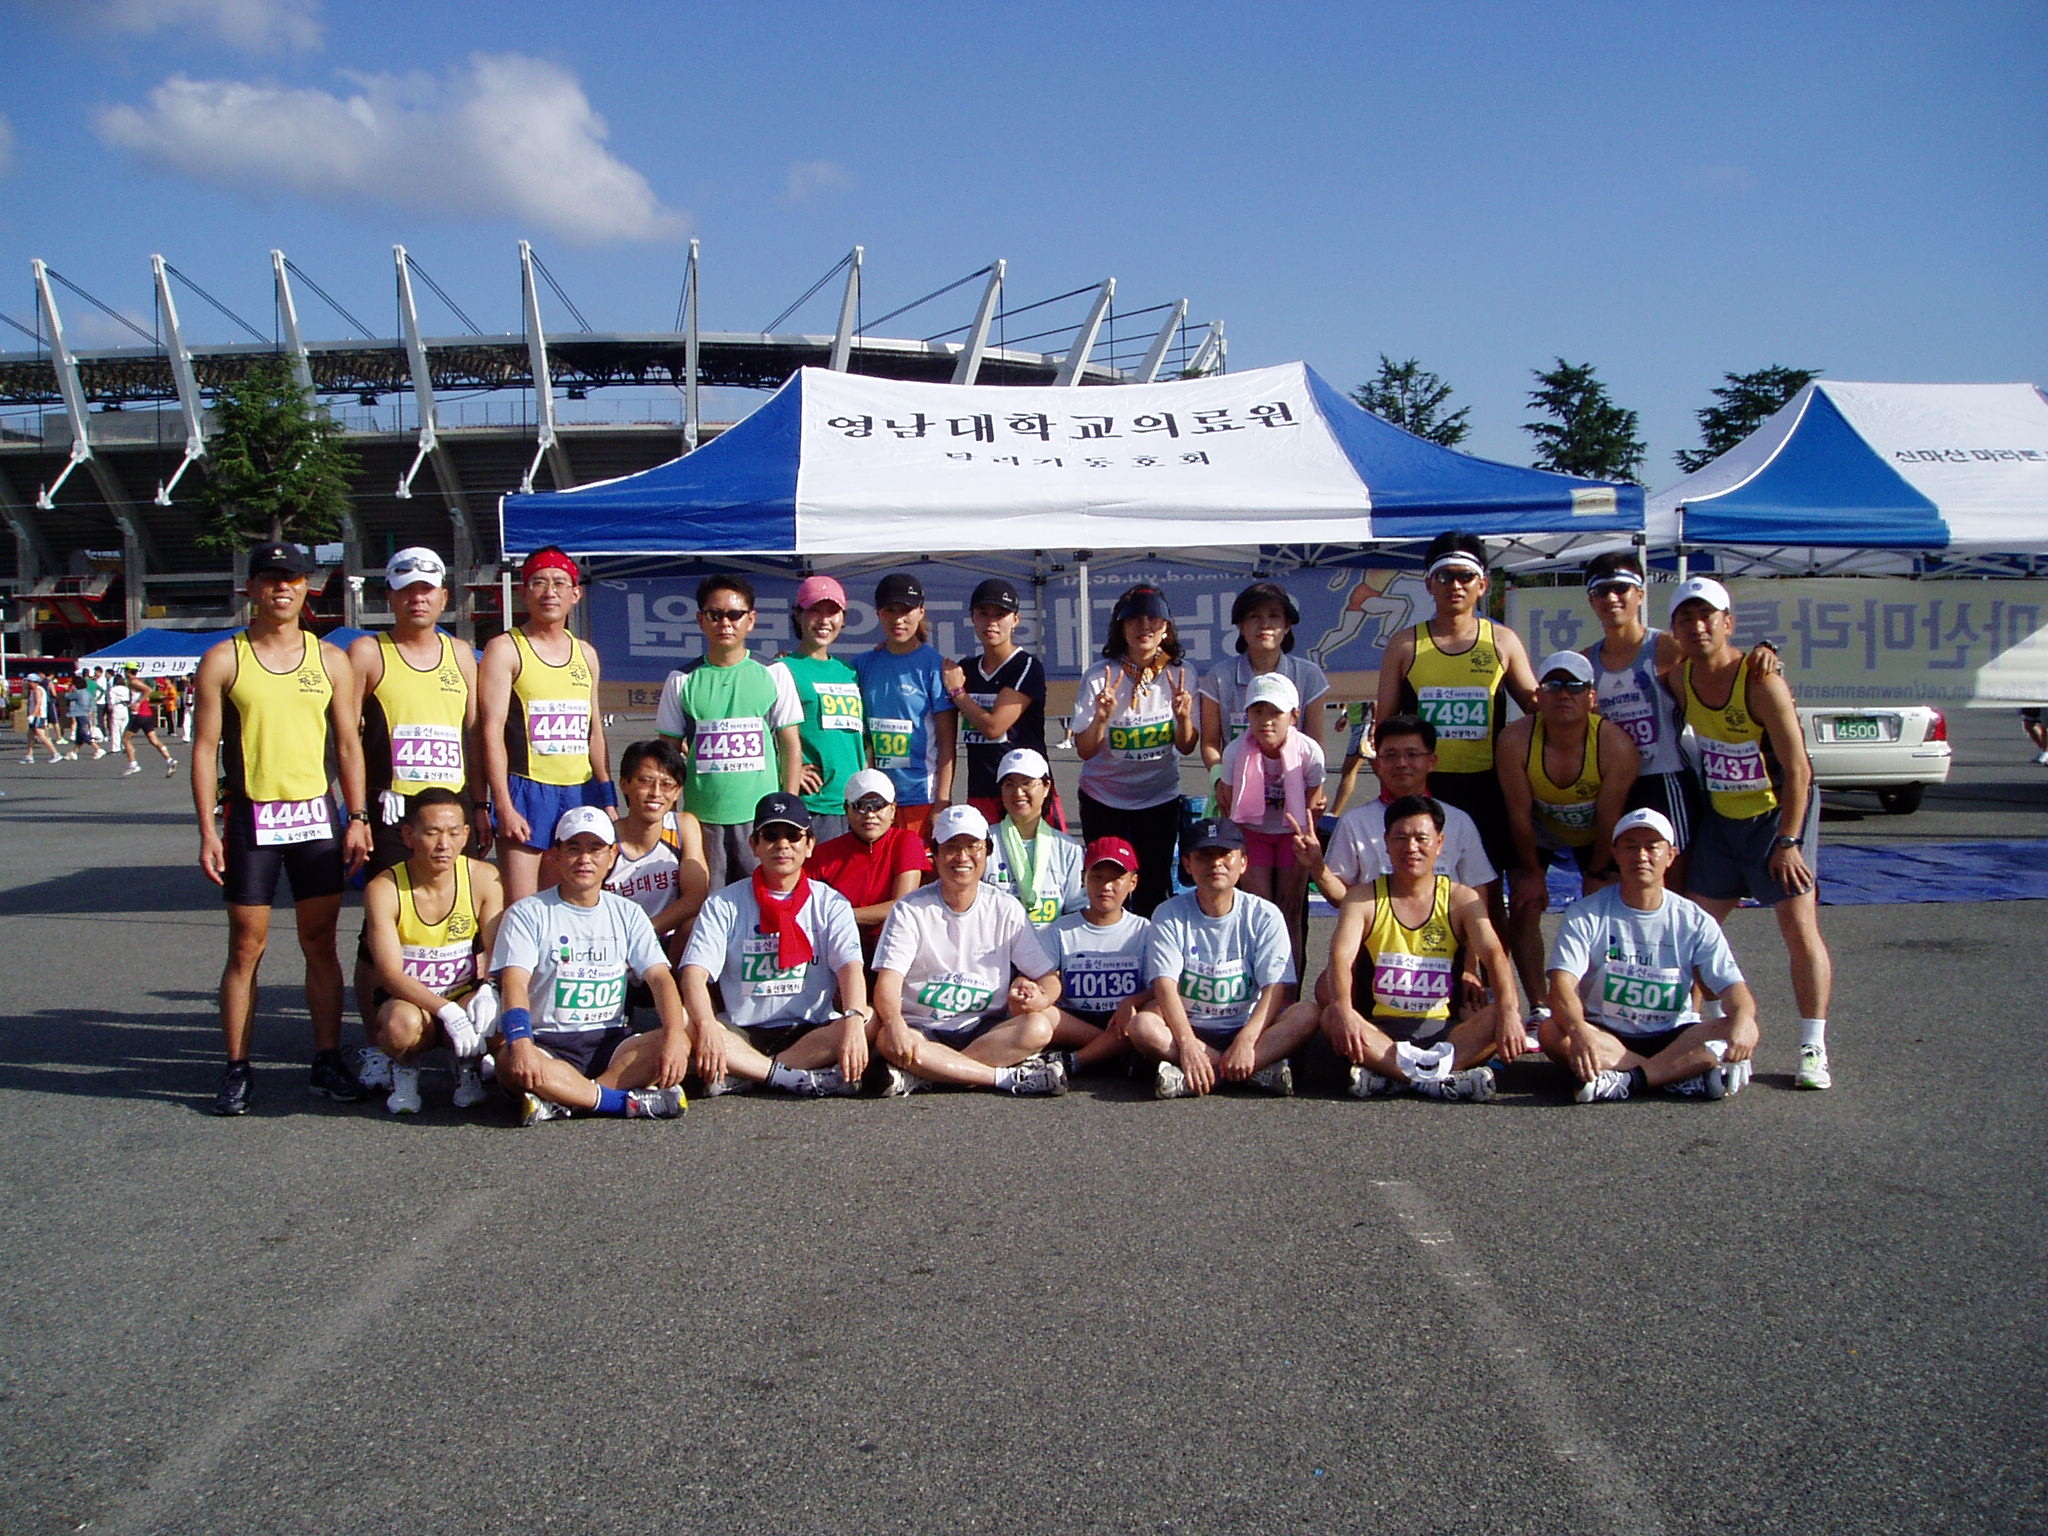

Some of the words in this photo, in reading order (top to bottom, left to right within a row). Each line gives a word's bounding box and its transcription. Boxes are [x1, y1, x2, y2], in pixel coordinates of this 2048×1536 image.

[828, 401, 1300, 444] 영남대학교의료원
[1421, 702, 1485, 724] 7494
[534, 715, 588, 740] 4445
[1112, 722, 1171, 748] 9124
[1839, 724, 1877, 738] 4500
[397, 740, 459, 766] 4435
[699, 733, 761, 758] 4433
[1703, 754, 1758, 779] 4437
[258, 797, 327, 828] 4440
[404, 958, 472, 985] 4432
[1070, 972, 1136, 997] 10136
[1378, 969, 1448, 996] 4444
[560, 979, 622, 1007] 7502
[924, 984, 990, 1012] 7495
[1184, 973, 1246, 1002] 7500
[1609, 977, 1676, 1009] 7501
